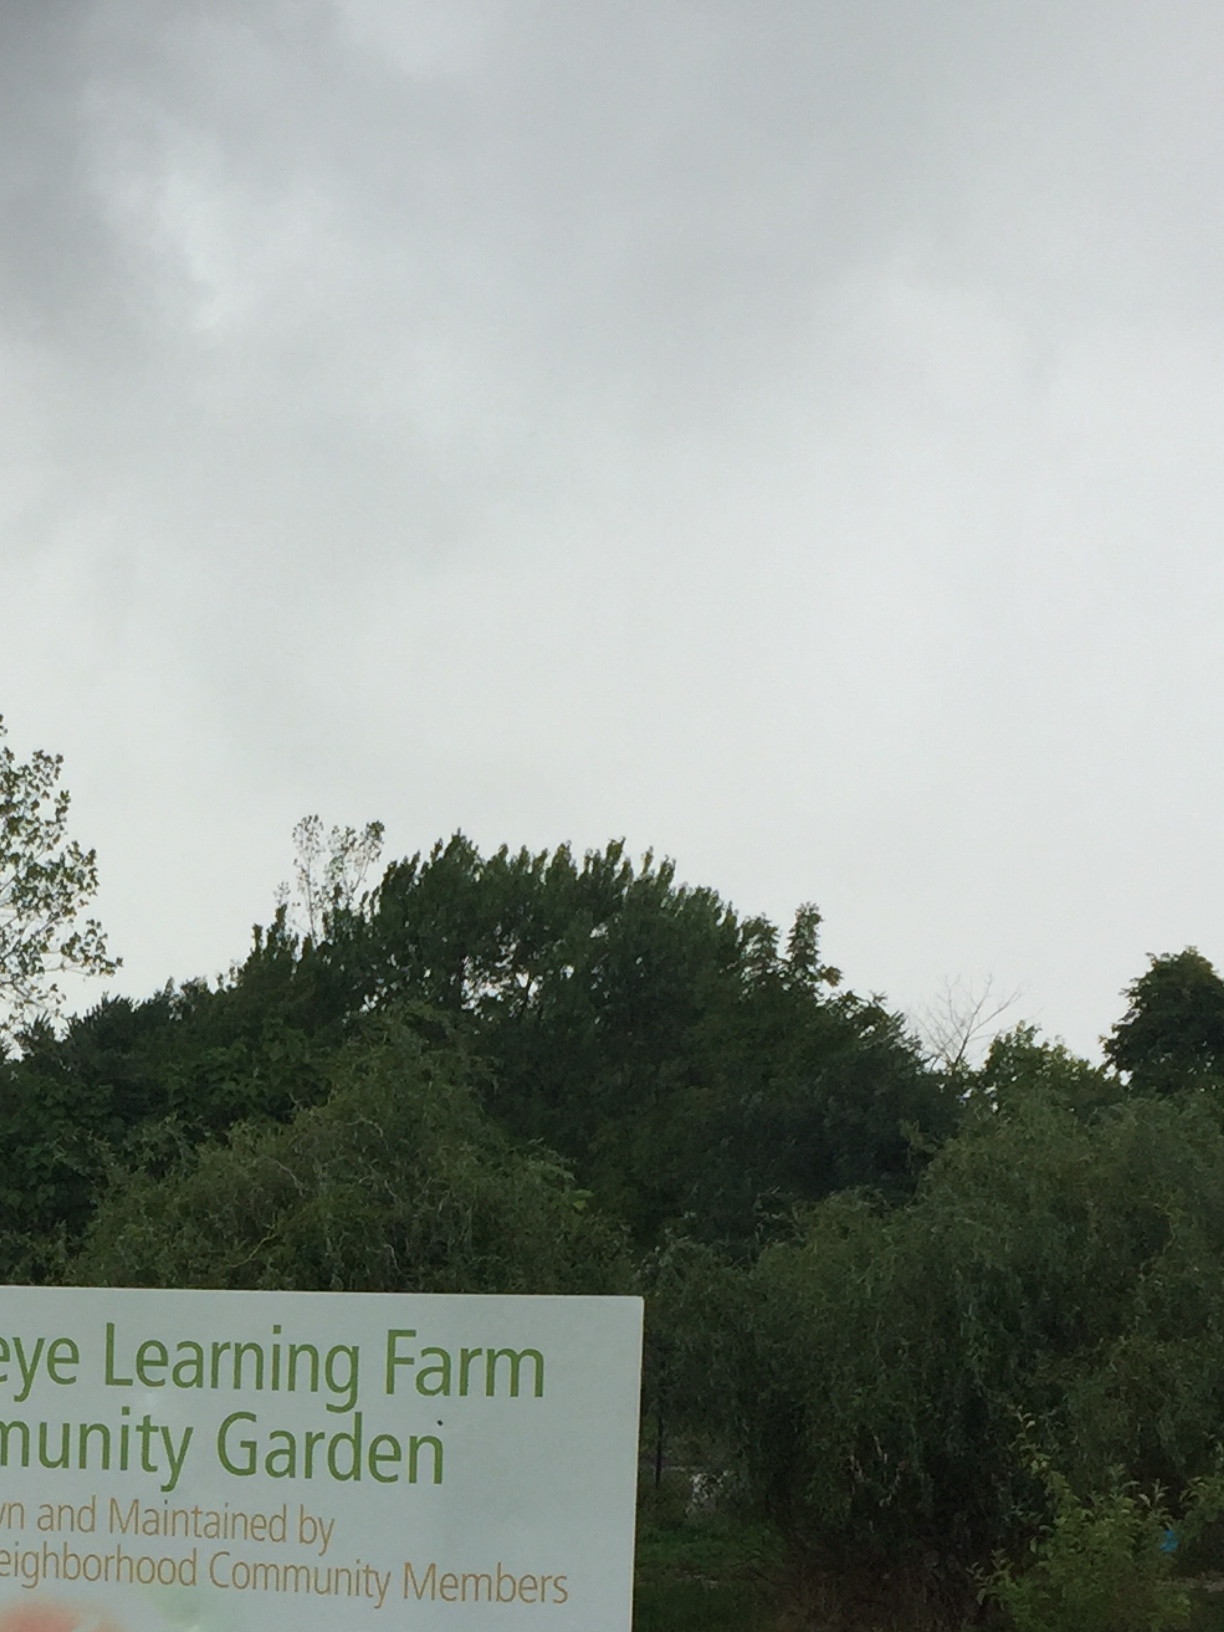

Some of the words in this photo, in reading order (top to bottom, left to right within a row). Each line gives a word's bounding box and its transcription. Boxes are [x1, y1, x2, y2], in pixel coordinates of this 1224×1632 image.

[104, 1322, 360, 1414] Learning
[385, 1329, 545, 1398] Farm
[216, 1411, 444, 1485] Garden
[37, 1495, 96, 1533] and
[109, 1497, 287, 1543] Maintained
[299, 1504, 335, 1557] by
[209, 1551, 391, 1610] Community
[403, 1561, 569, 1604] Members
